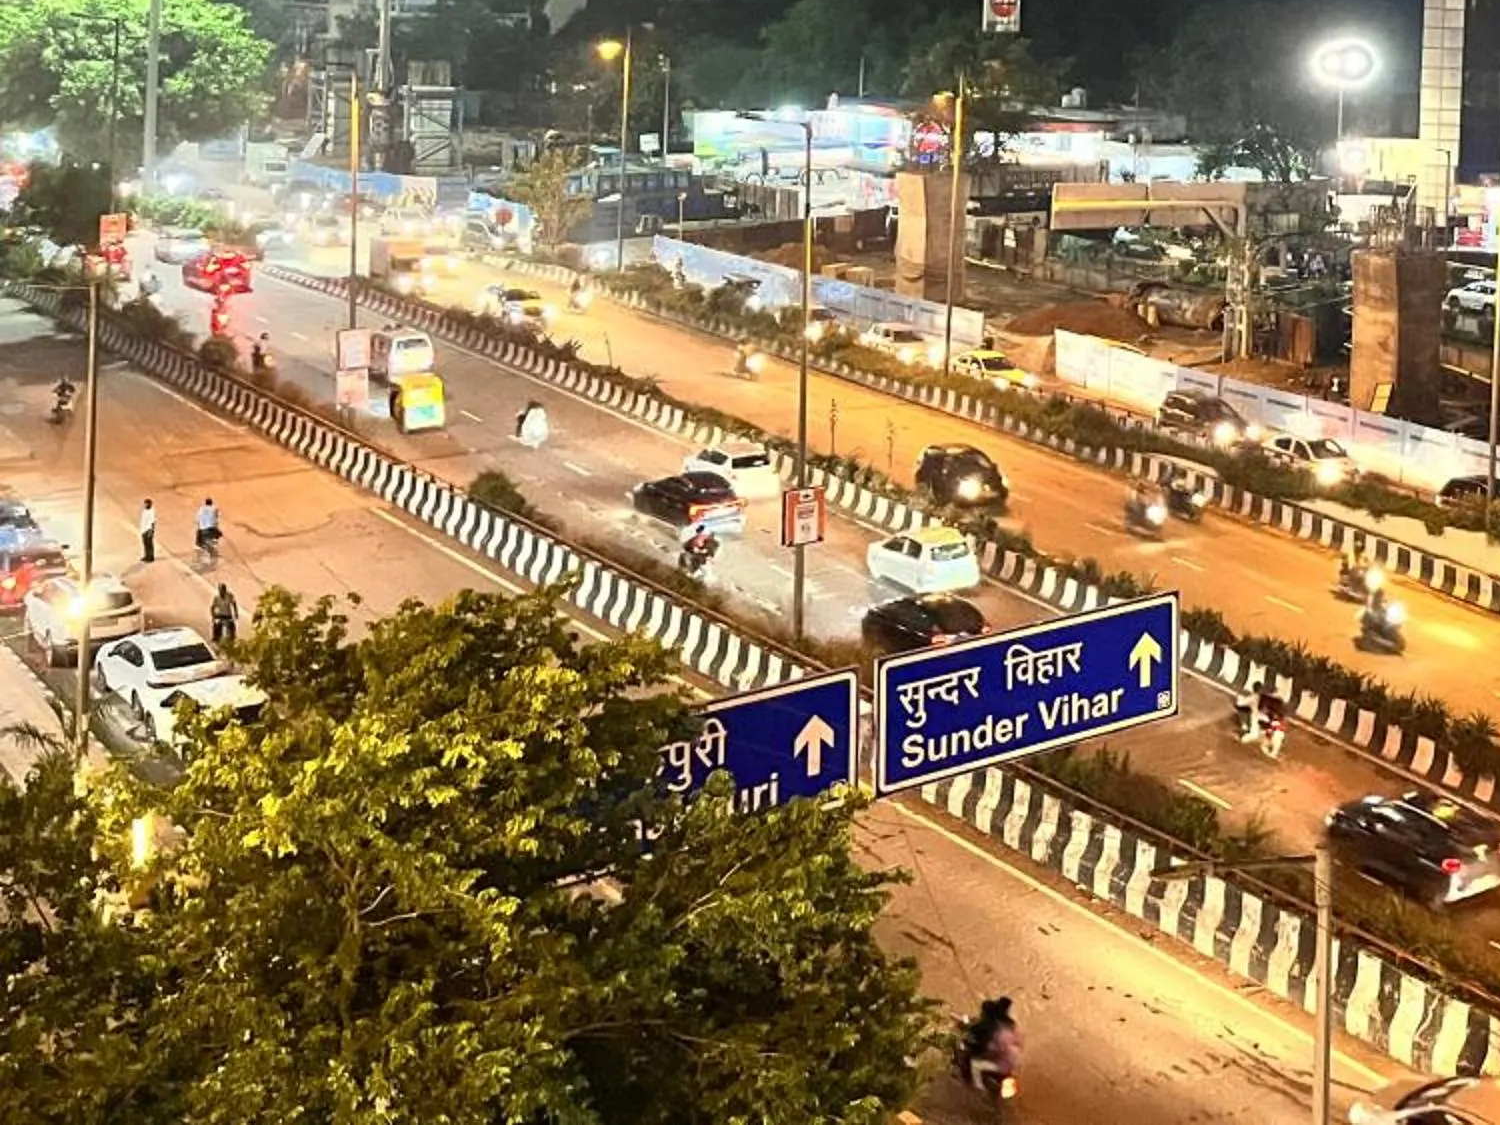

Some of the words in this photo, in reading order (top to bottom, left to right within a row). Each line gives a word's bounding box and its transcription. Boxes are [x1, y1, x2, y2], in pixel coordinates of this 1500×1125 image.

[896, 666, 981, 728] सुन्दर
[1003, 643, 1083, 691] विहार
[901, 712, 1029, 769] Sunder
[1038, 686, 1125, 731] Vihar
